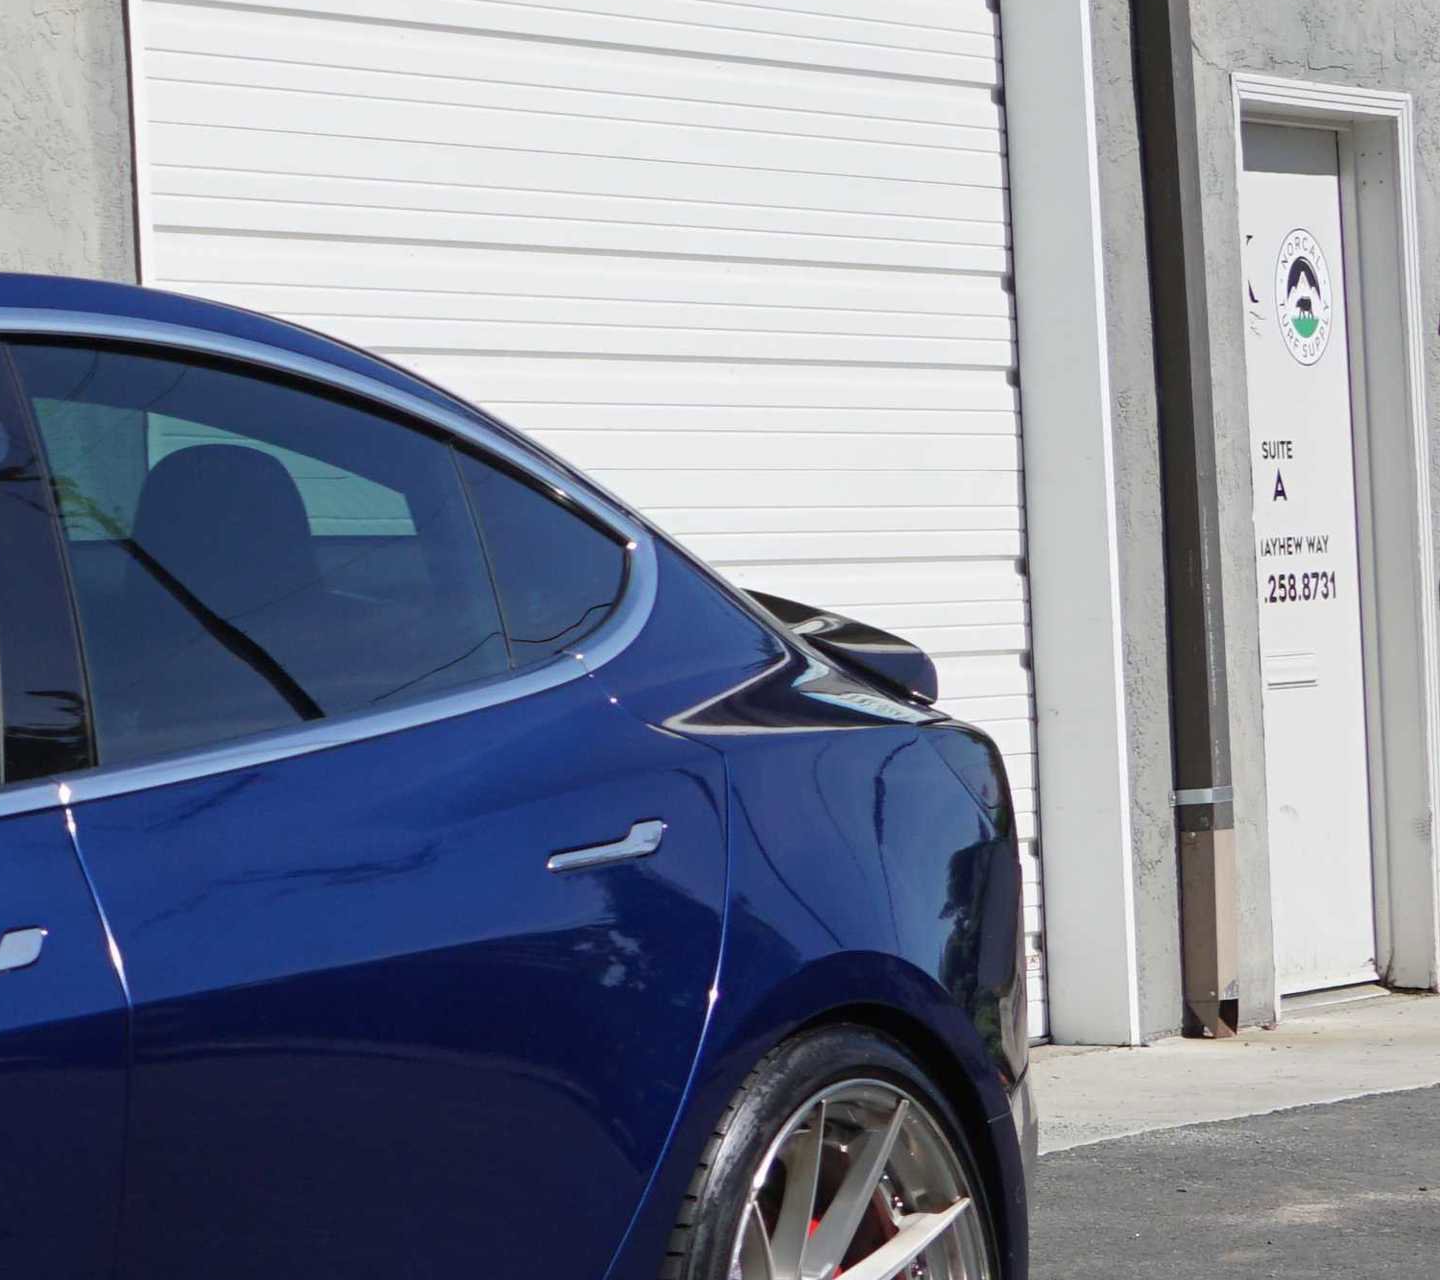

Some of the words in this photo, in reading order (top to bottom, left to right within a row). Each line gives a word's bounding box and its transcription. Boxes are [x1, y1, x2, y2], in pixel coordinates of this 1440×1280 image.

[1261, 439, 1293, 460] SUITE
[1272, 469, 1288, 502] A
[1261, 536, 1303, 557] AYHEW
[1306, 534, 1329, 554] WAY
